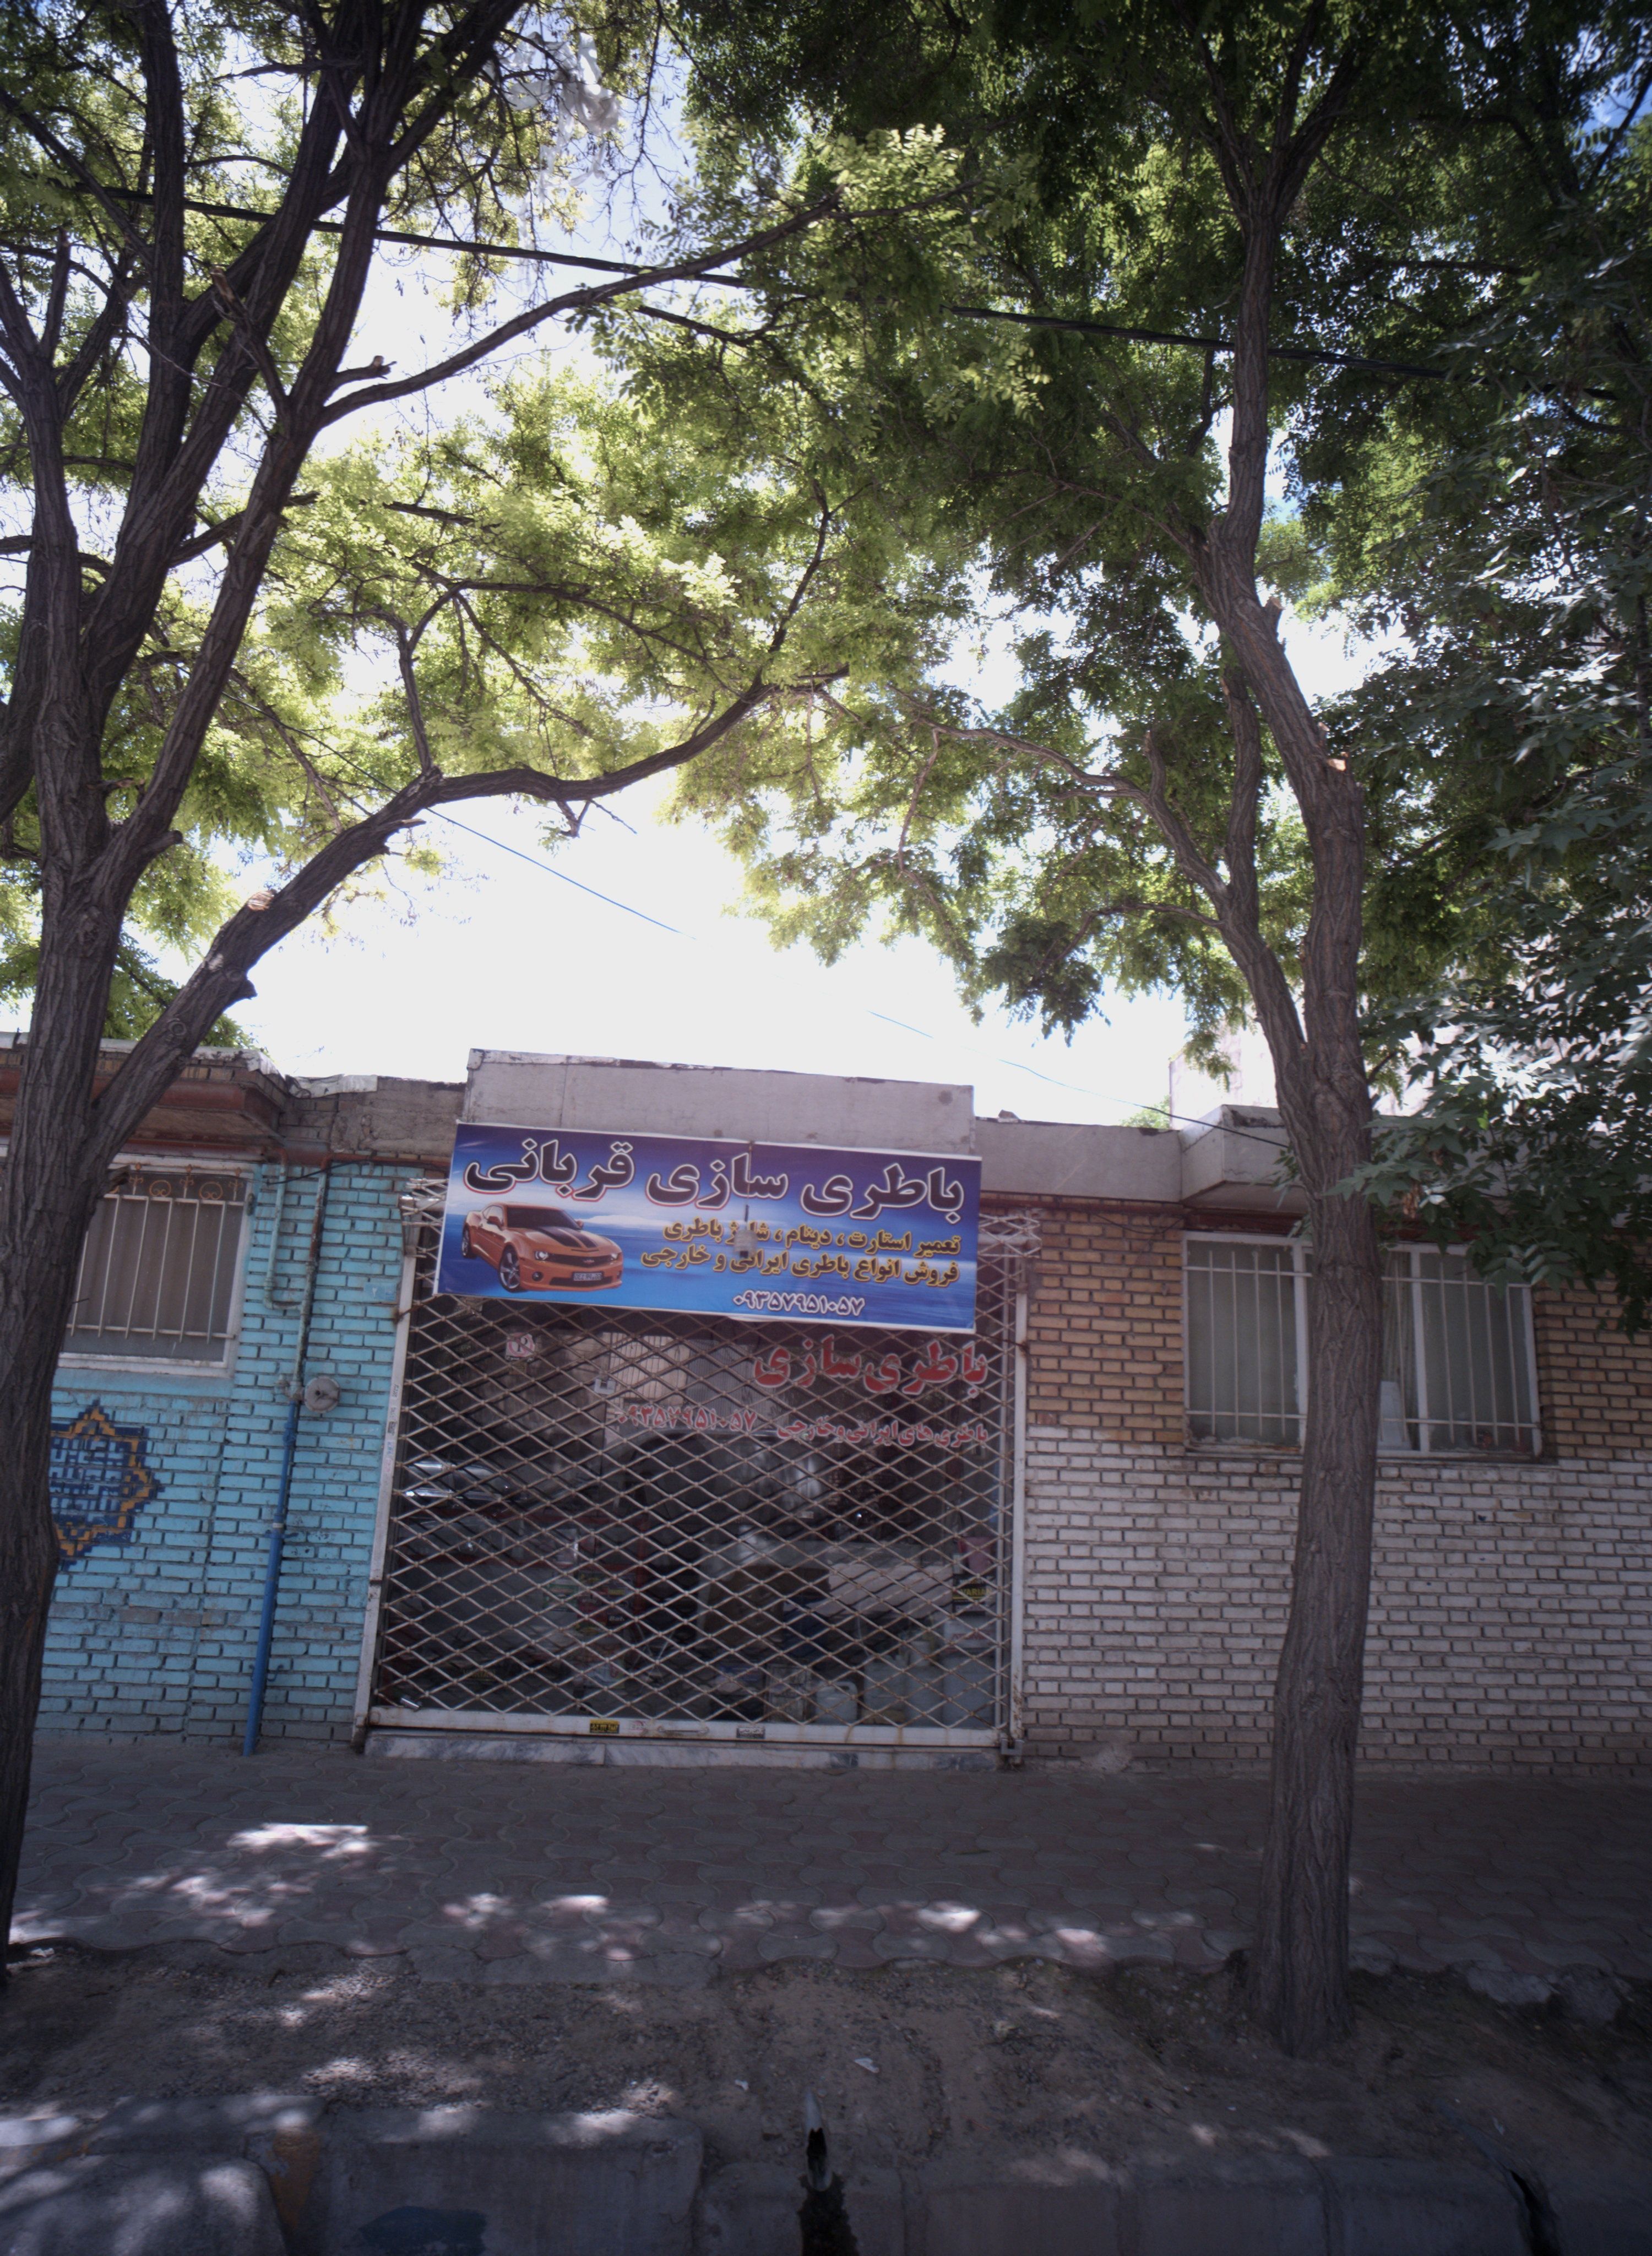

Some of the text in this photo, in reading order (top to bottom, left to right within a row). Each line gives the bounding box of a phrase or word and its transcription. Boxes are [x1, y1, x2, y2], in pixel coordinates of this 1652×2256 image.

[463, 1138, 964, 1224] باطری سازی قربانی
[663, 1216, 724, 1243] باطری
[785, 1224, 833, 1250] دینام
[848, 1229, 912, 1255] استارت
[640, 1243, 711, 1269] خارجی
[913, 1235, 961, 1259] تعمیر
[713, 1253, 727, 1272] و
[791, 1252, 851, 1279] باطری
[854, 1257, 901, 1283] انواع
[903, 1261, 959, 1287] فروش
[732, 1289, 866, 1317] ۰۹۳۵۷۹۵۱۰۵۷
[753, 1333, 989, 1399] باطری سازی
